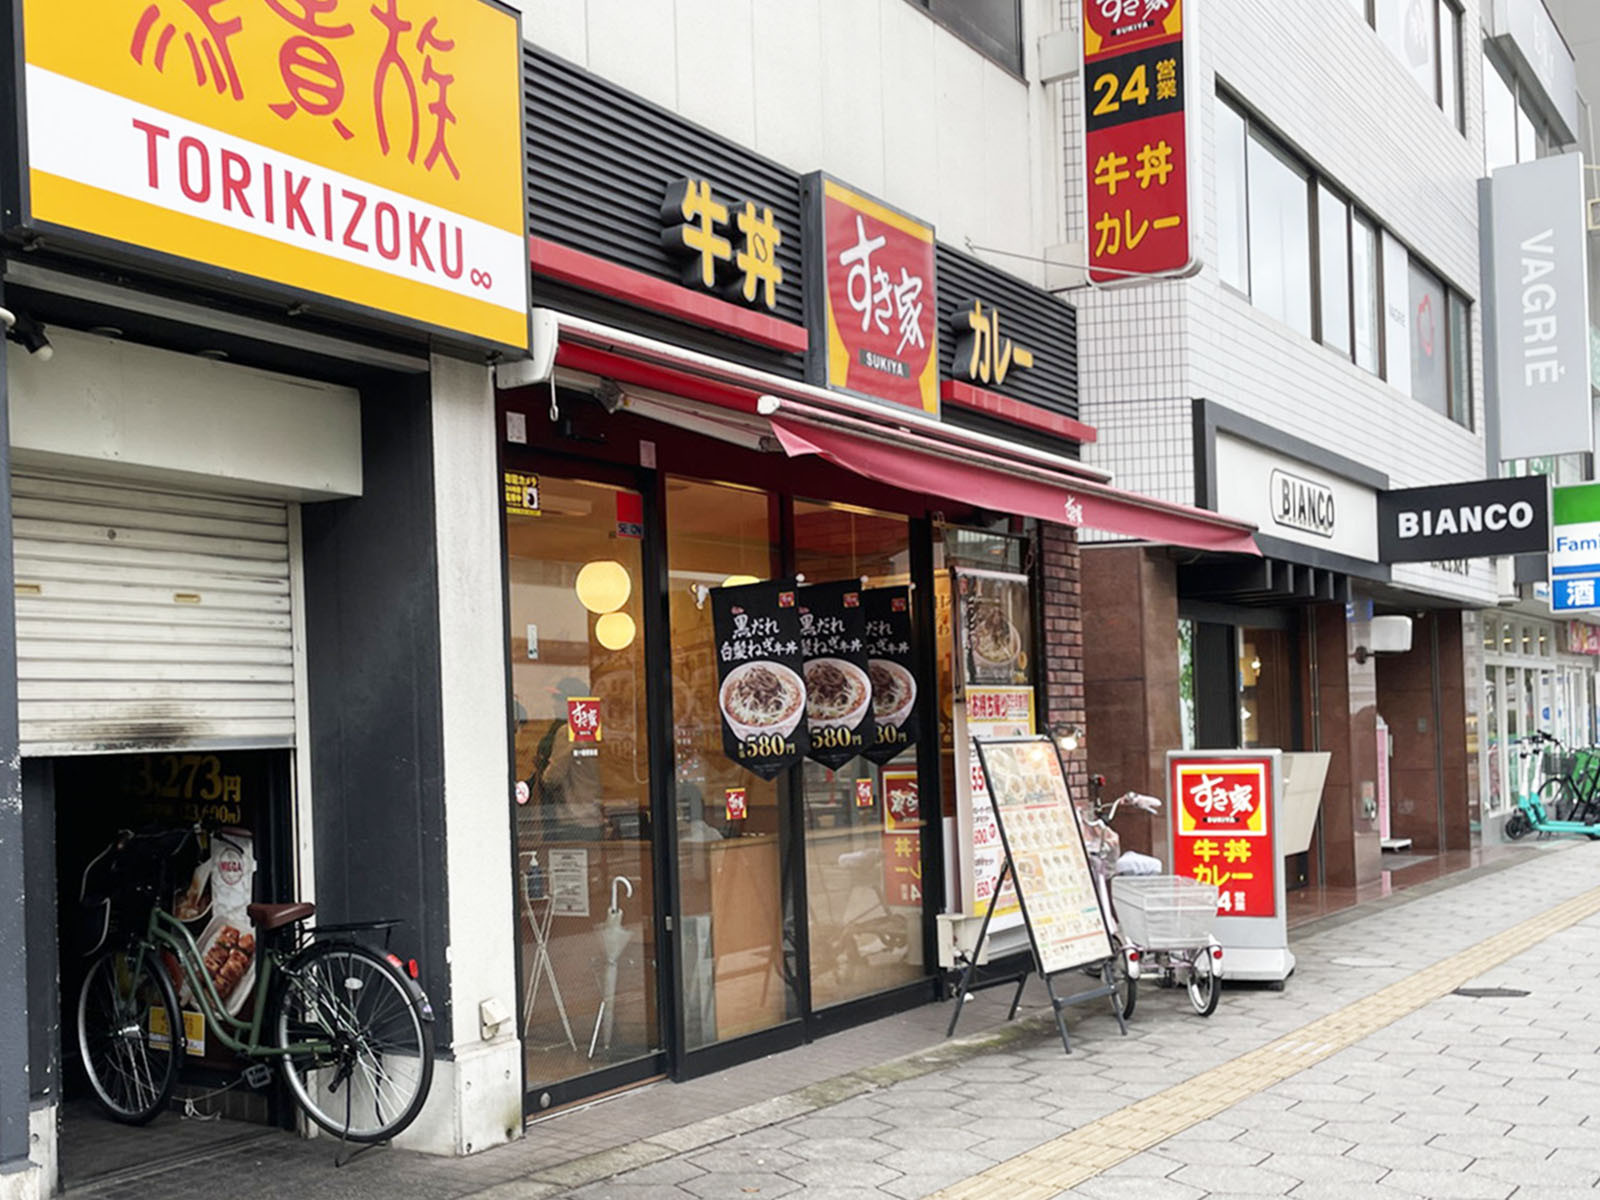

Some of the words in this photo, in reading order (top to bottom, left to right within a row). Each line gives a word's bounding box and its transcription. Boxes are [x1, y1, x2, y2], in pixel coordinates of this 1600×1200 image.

[1094, 140, 1174, 196] 牛丼
[132, 117, 464, 280] TORIKIZOKU
[682, 178, 783, 310] 牛丼
[1094, 208, 1182, 258] カレー
[839, 214, 925, 356] すき家
[968, 299, 1034, 384] カレー
[866, 351, 904, 377] SUKIYA
[1281, 478, 1335, 528] BIANCO
[1398, 501, 1535, 539] BIANCO
[1556, 535, 1600, 553] Fam
[1566, 579, 1596, 607] 酒
[732, 614, 781, 640] 黒だれ
[799, 613, 846, 637] 黒だれ
[1190, 774, 1254, 817] すき家
[1193, 838, 1252, 864] 牛丼
[1193, 864, 1254, 887] カレー
